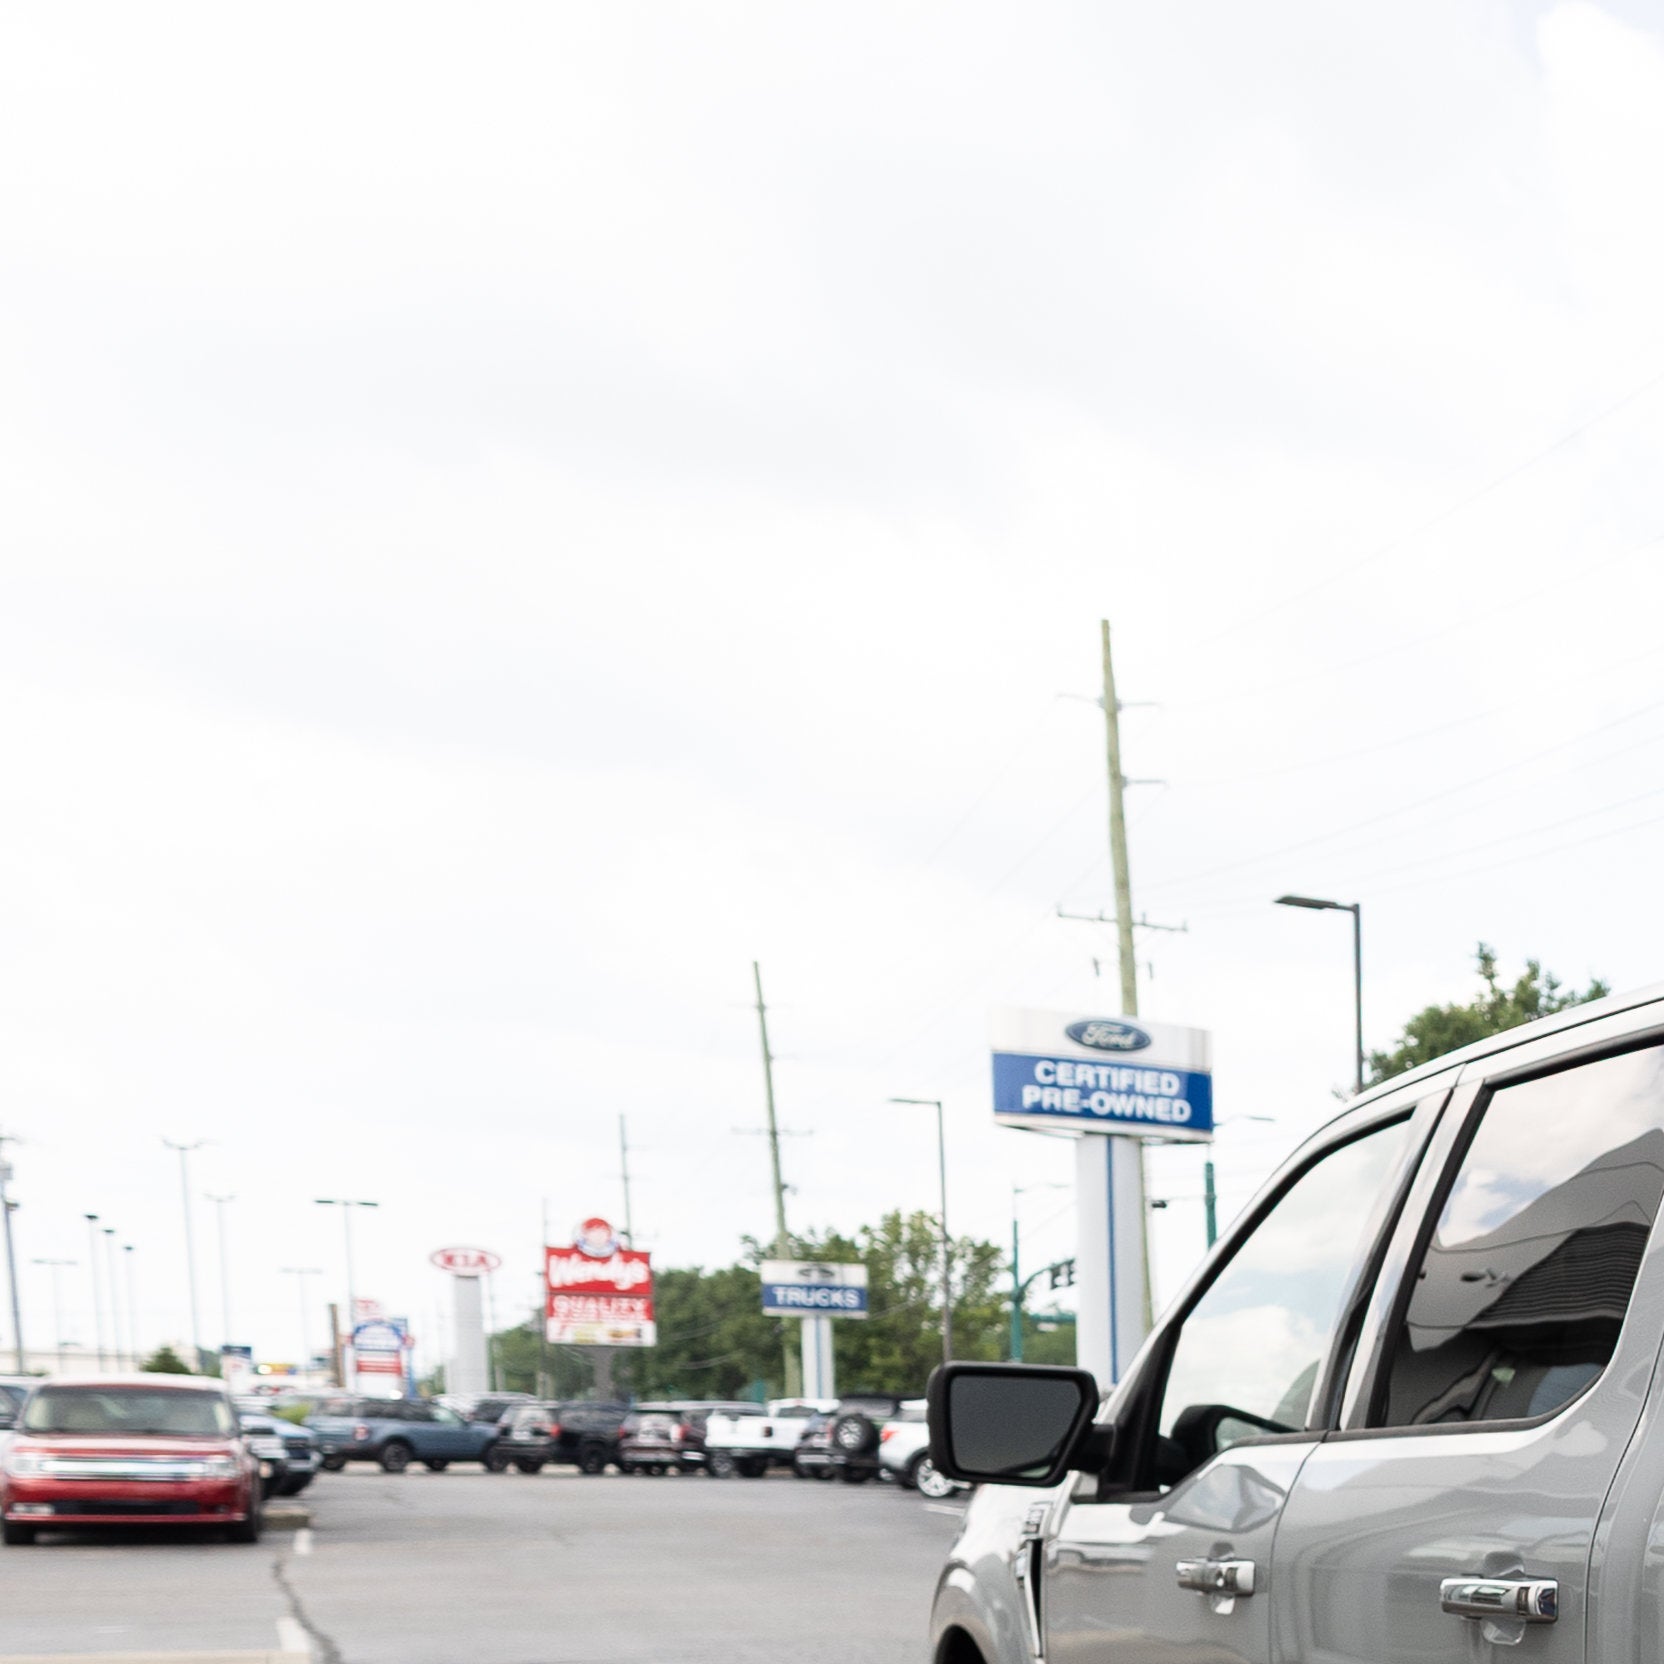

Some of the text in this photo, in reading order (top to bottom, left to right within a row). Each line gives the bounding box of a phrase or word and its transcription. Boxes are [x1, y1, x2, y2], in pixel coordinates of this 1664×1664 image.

[1034, 1060, 1181, 1096] CERTIFIED
[1022, 1085, 1192, 1122] PRE-OWNED
[548, 1252, 649, 1291] Wendy's
[772, 1286, 860, 1308] TRUCKS
